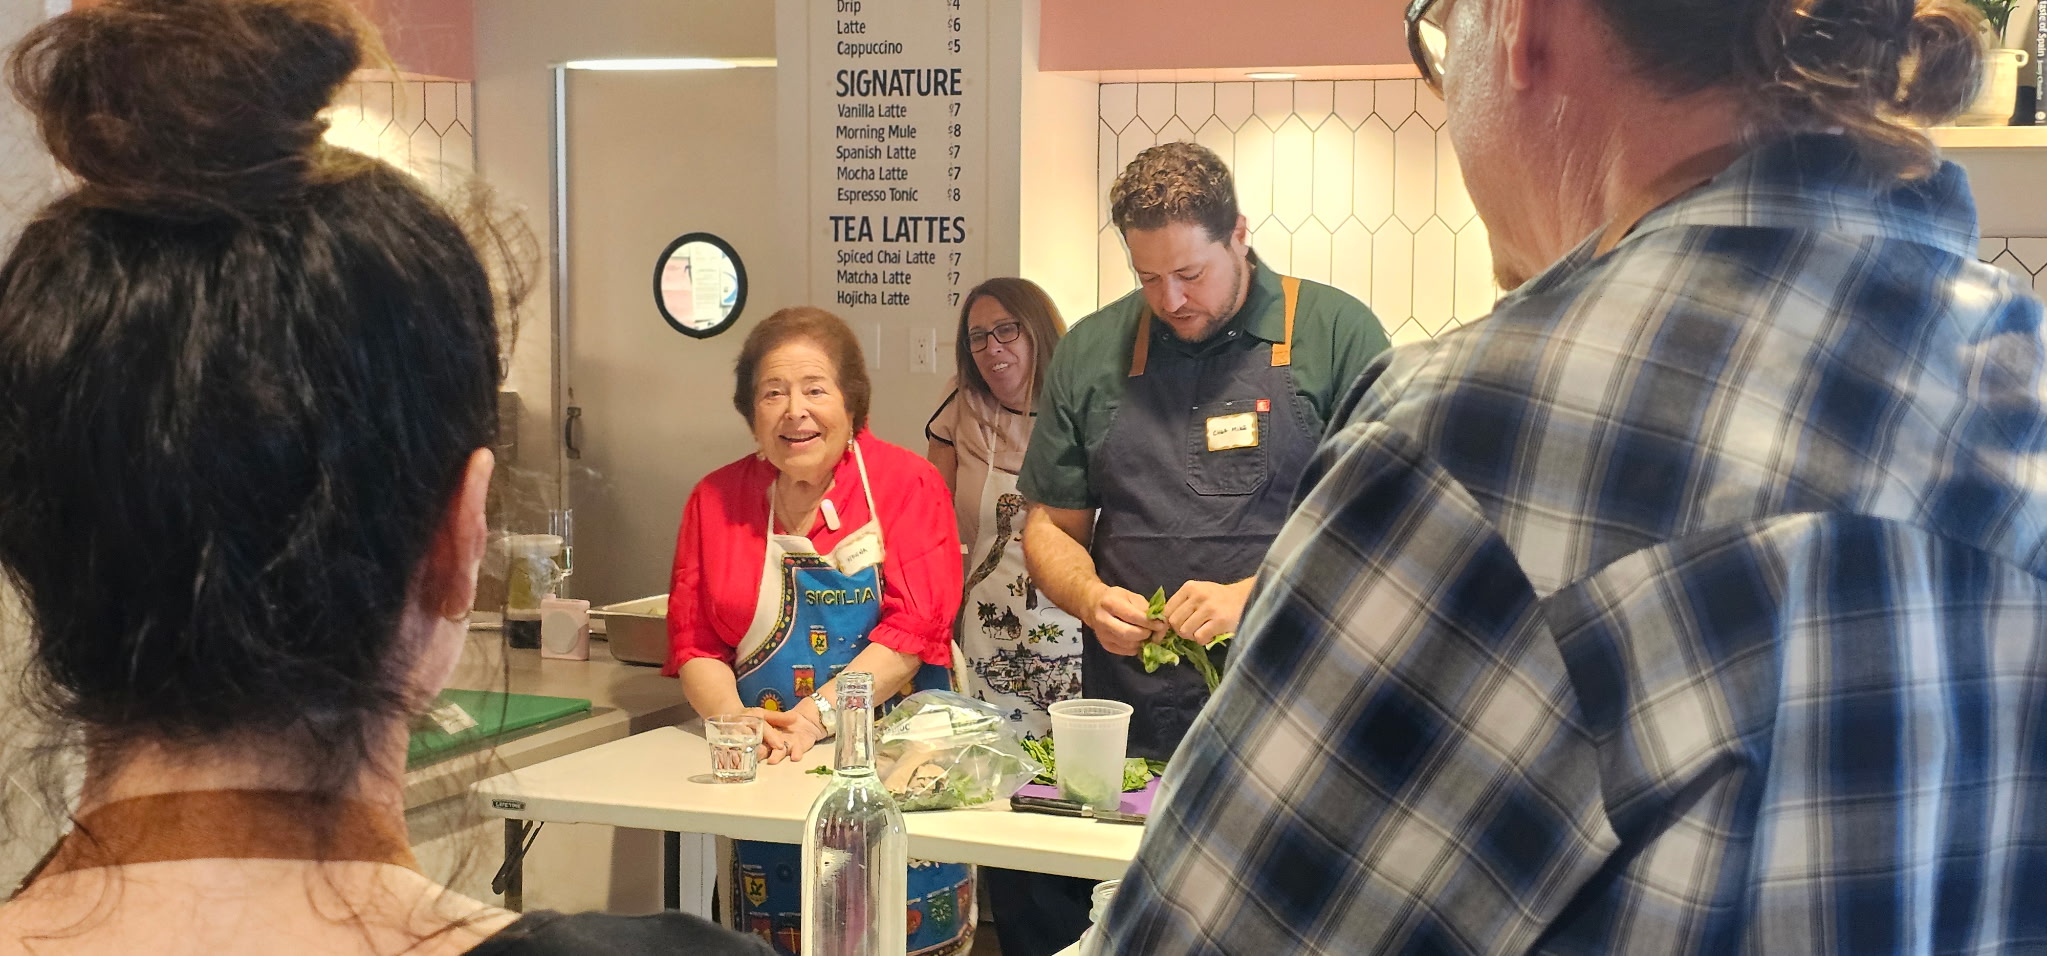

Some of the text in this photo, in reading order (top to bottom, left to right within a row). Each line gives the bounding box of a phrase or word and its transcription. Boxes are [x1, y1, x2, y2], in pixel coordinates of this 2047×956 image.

[837, 0, 861, 15] Drip
[837, 20, 866, 34] Latte
[837, 40, 903, 58] Cappuccino
[2037, 33, 2047, 57] Spain
[836, 68, 962, 97] SIGNATURE
[837, 103, 875, 118] Vanilla
[878, 104, 907, 118] Latte
[836, 124, 885, 142] Morning
[888, 125, 917, 139] Mule
[836, 145, 882, 163] Spanish
[886, 145, 916, 159] Latte
[836, 166, 875, 180] Mocha
[879, 166, 908, 180] Latte
[837, 187, 886, 204] Espresso
[889, 187, 918, 201] Tonic
[829, 216, 966, 243] TEA LATTES
[837, 249, 873, 266] Spiced
[877, 250, 901, 264] Chai
[906, 250, 936, 264] Latte
[836, 270, 878, 284] Matcha
[882, 270, 911, 284] Latte
[837, 290, 877, 307] Hojicha
[881, 291, 910, 305] Latte
[805, 587, 876, 605] SICILIA
